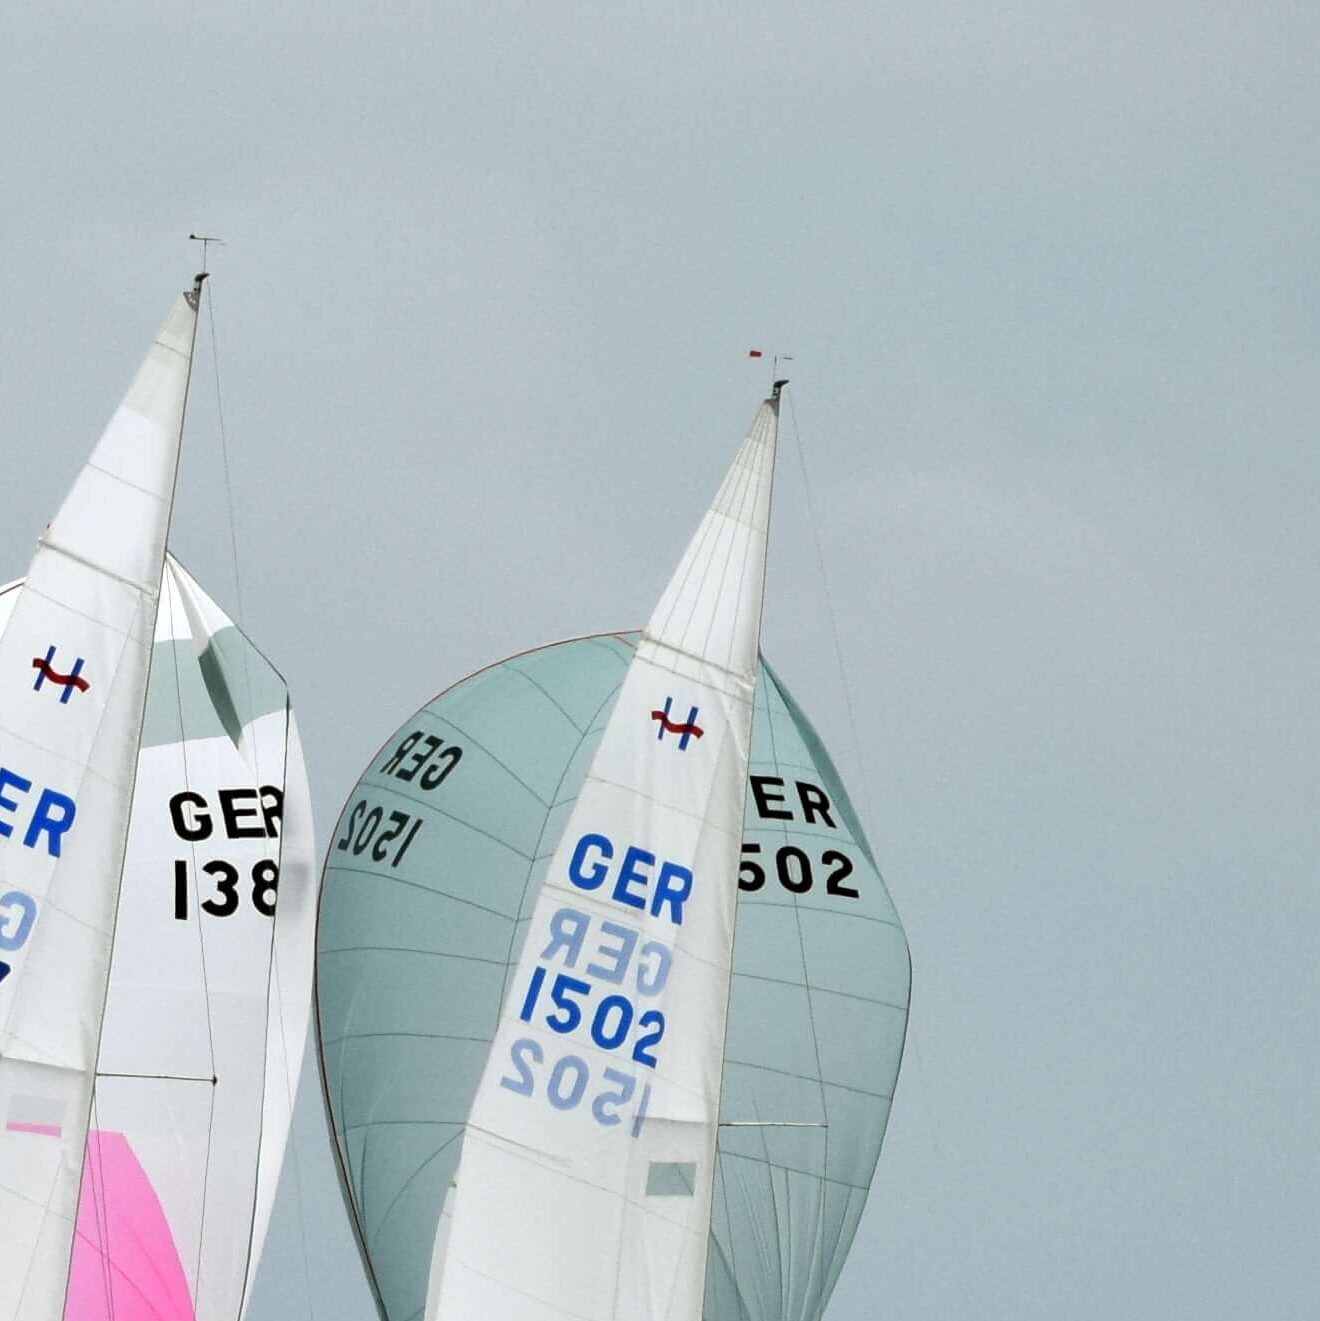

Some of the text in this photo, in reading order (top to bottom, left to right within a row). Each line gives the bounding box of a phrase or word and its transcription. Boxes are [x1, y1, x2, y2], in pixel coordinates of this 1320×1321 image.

[169, 785, 283, 841] GER
[175, 859, 279, 920] 138
[567, 832, 694, 927] GER
[738, 843, 860, 899] 502
[519, 966, 665, 1069] 1502
